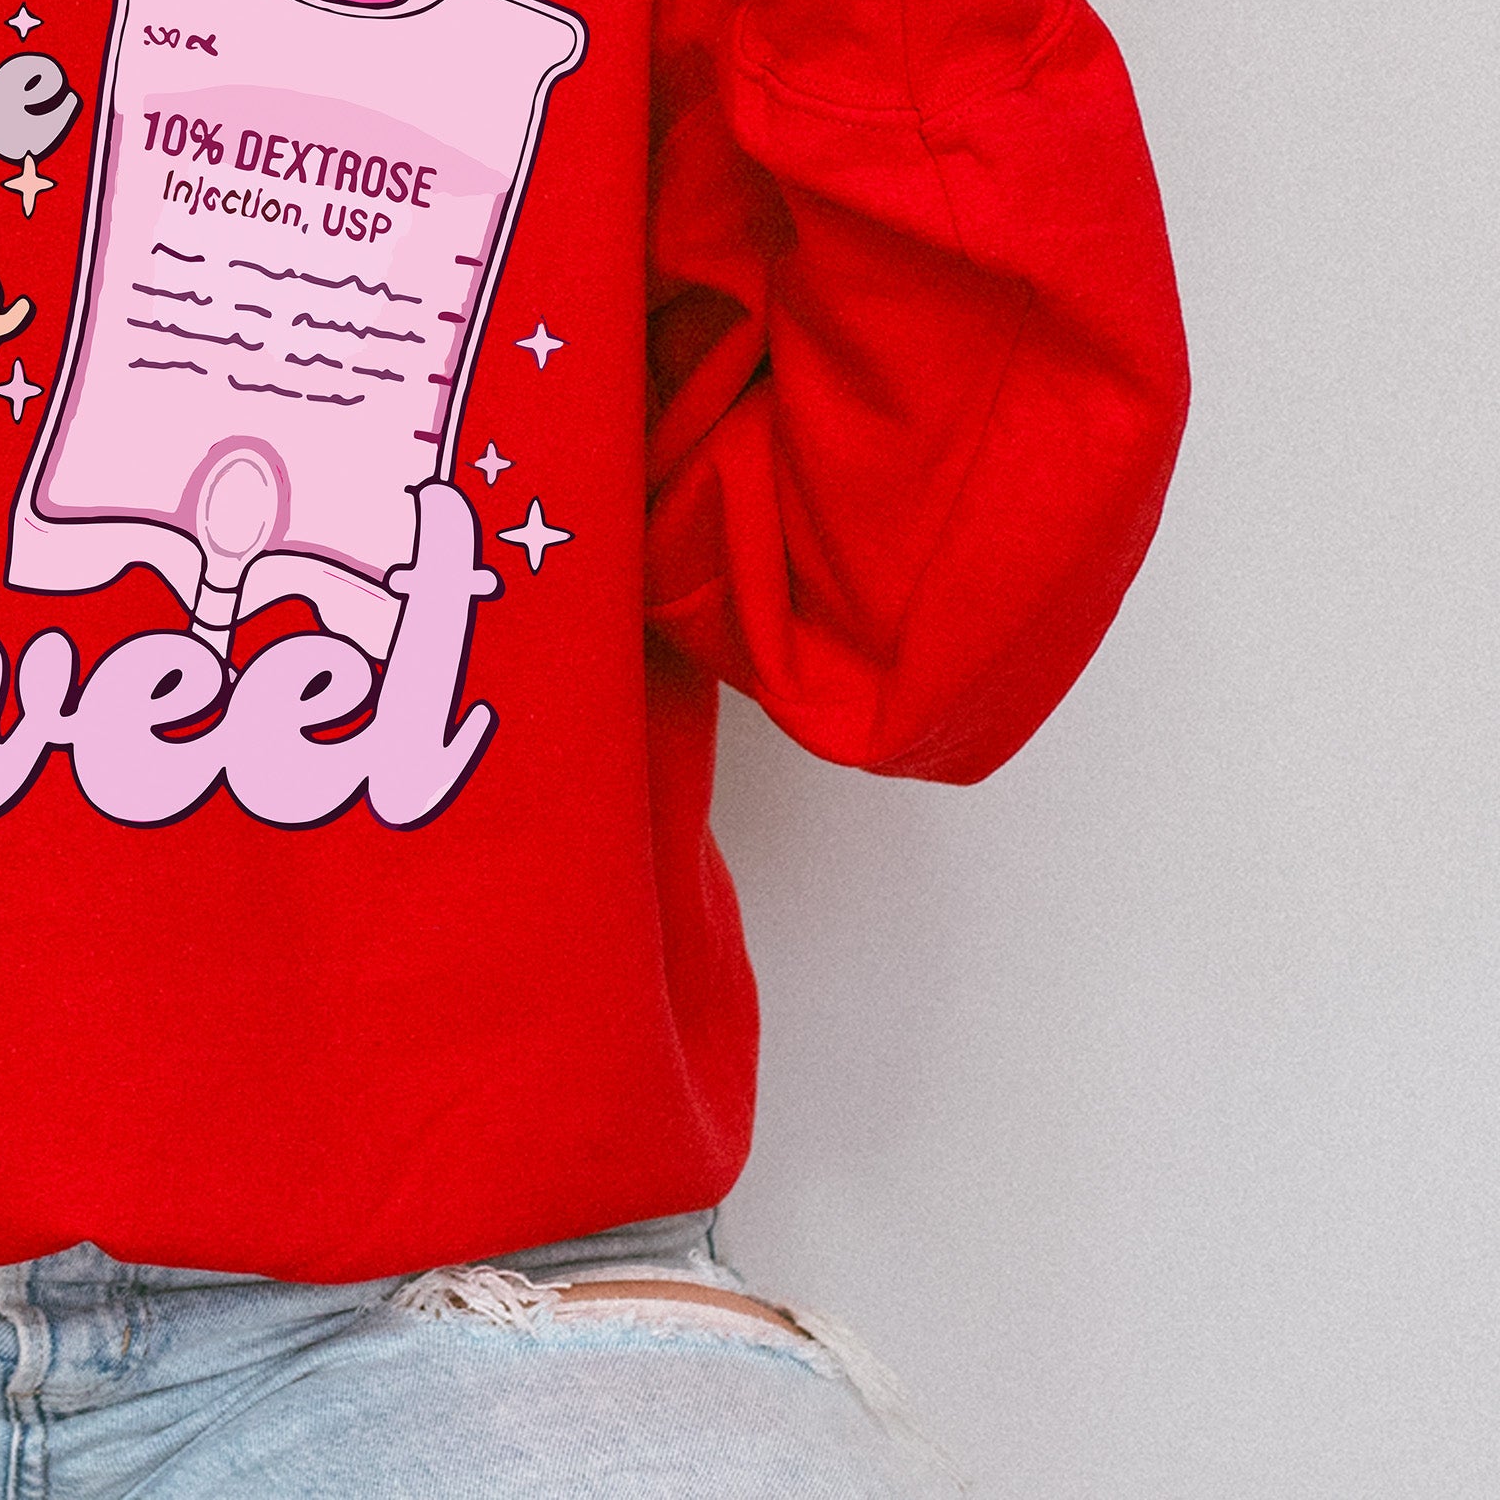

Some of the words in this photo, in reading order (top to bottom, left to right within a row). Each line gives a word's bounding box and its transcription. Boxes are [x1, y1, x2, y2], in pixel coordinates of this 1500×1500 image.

[144, 111, 225, 166] 10%
[234, 129, 438, 209] DEXTROSE
[322, 202, 393, 244] USP
